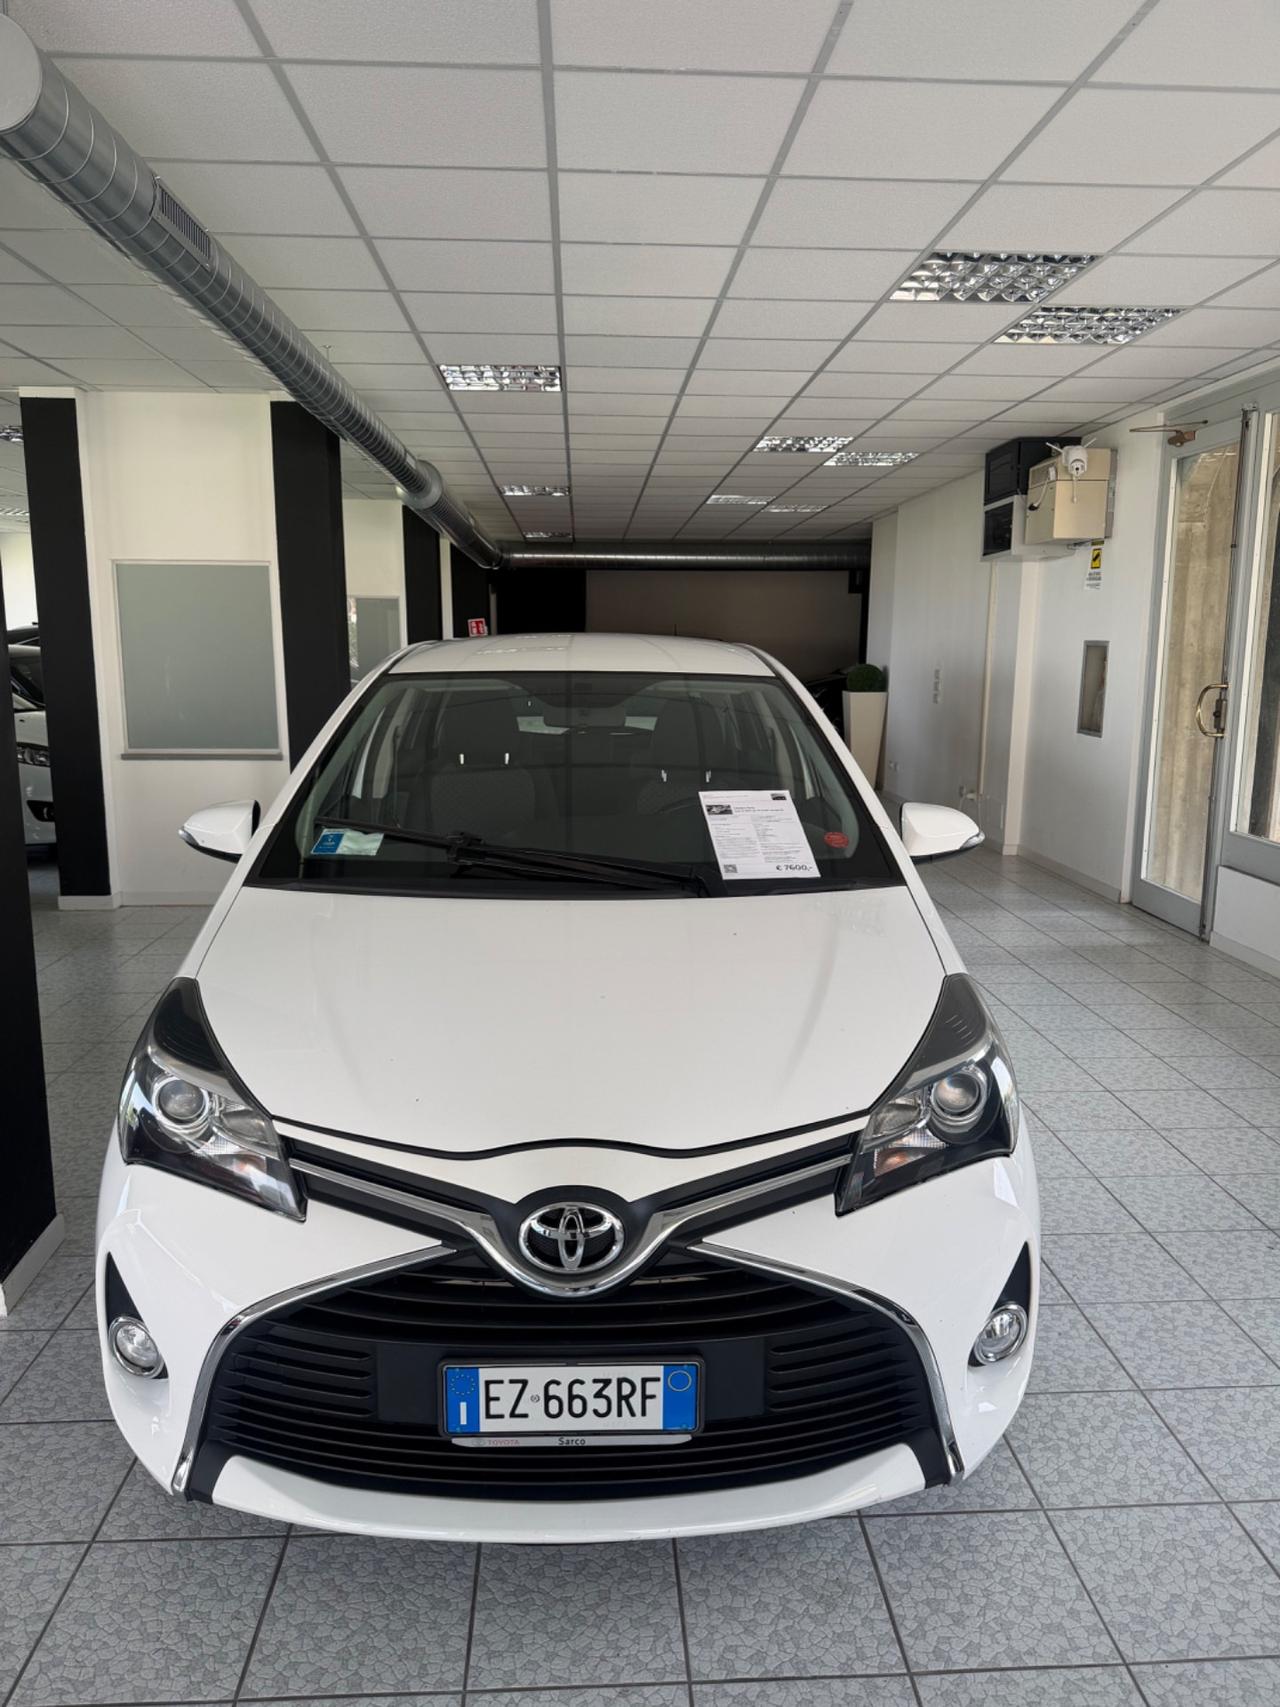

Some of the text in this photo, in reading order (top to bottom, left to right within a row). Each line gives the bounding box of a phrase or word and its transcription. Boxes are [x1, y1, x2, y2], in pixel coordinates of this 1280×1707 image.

[484, 1378, 530, 1420] EZ
[543, 1376, 661, 1419] 663RF
[487, 1437, 587, 1446] TOYOTA Sarco
